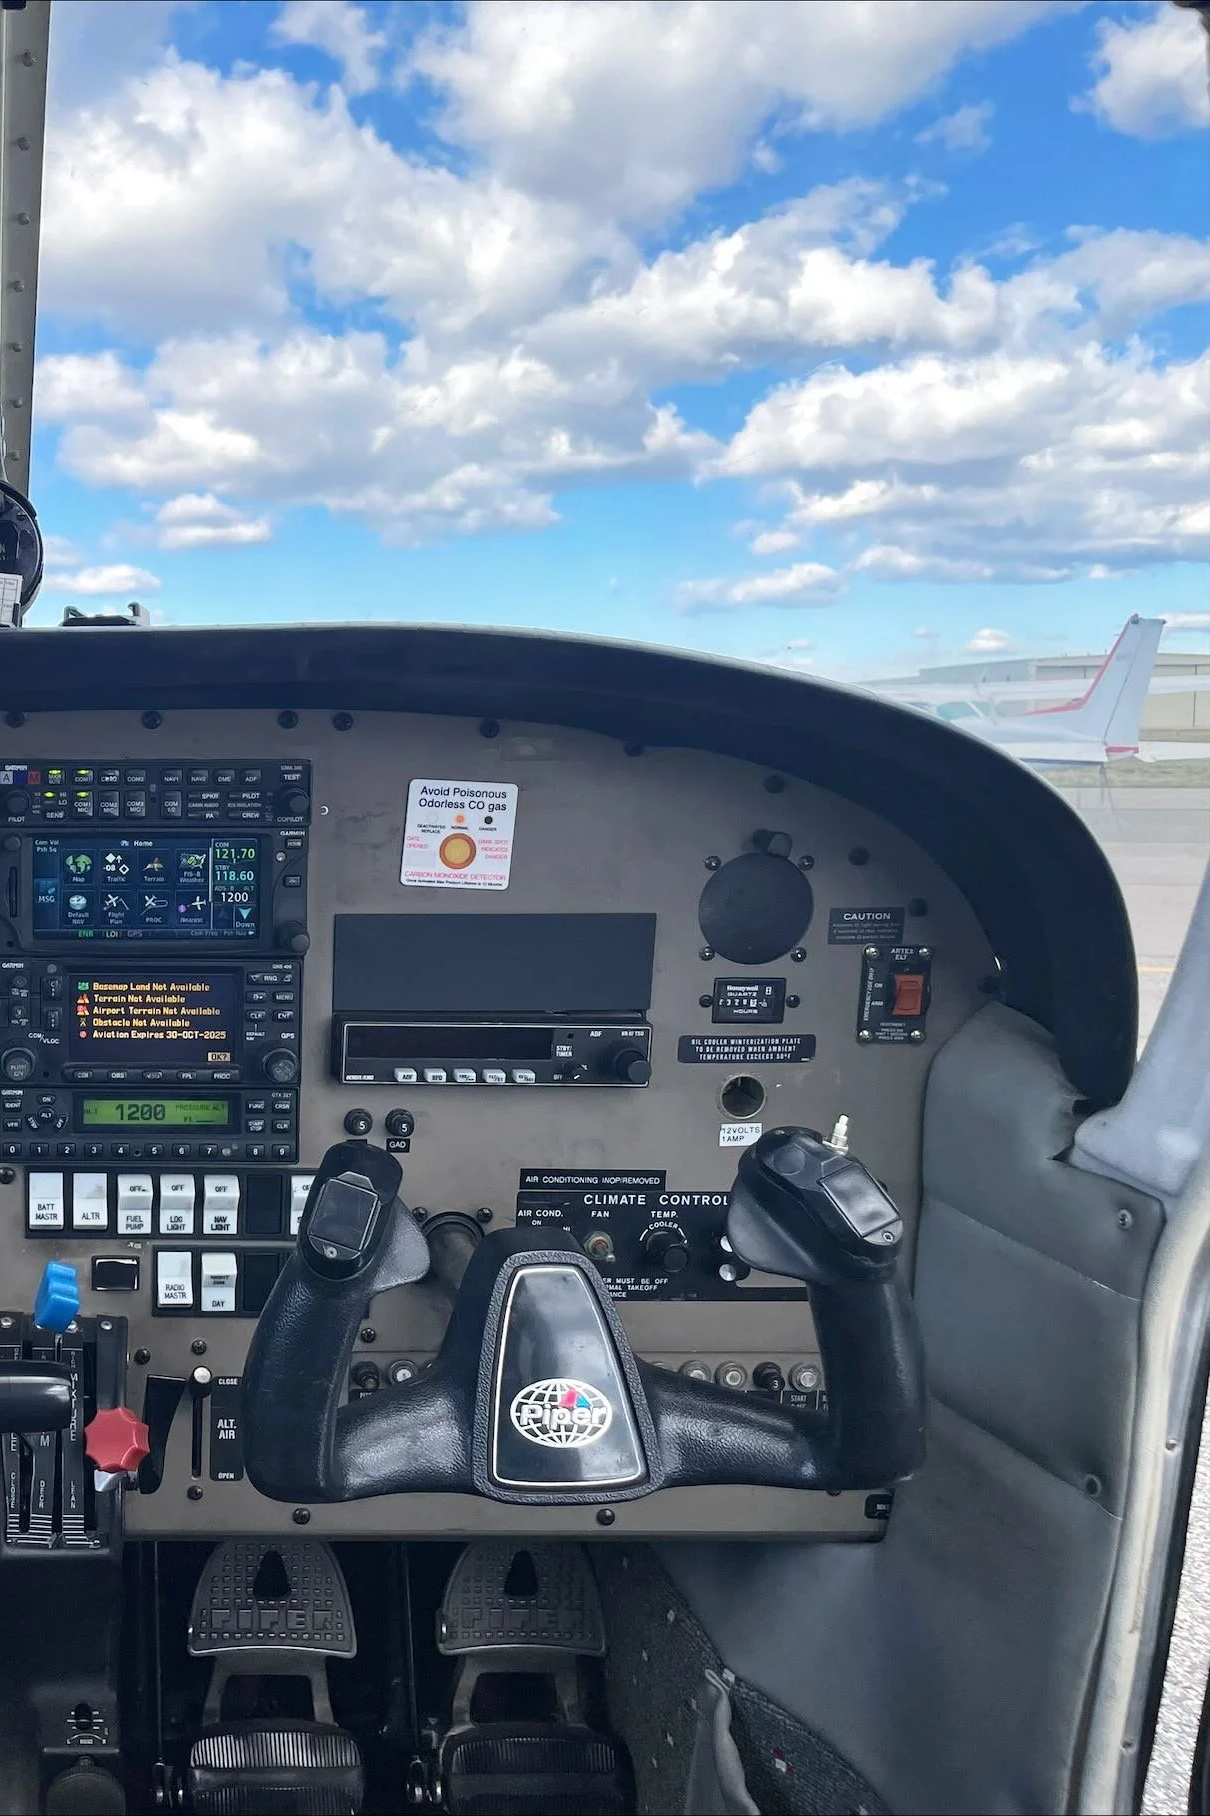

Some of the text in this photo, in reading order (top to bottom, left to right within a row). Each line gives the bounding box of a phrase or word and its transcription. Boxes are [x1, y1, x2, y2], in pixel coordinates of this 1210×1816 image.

[420, 786, 507, 798] Avoid Poisonous
[419, 798, 506, 812] Odorless CO gas
[215, 848, 255, 859] 121.70
[215, 871, 254, 881] 118.60
[220, 892, 248, 902] 1200
[93, 982, 210, 992] Basemap Land Not Available
[94, 994, 185, 1003] Terrain Not Available
[93, 1006, 220, 1016] Airport Terrain Not Available
[93, 1018, 190, 1028] Obstacle Not Available
[93, 1030, 226, 1040] Aviation Expires 30-OCT-2025
[115, 1104, 166, 1121] 1200
[543, 1176, 598, 1184] CONDITIONING
[602, 1177, 660, 1185] INOP/REMOVED
[584, 1195, 728, 1205] CLIMATE CONTROL
[36, 1213, 58, 1221] MASTR
[82, 1212, 100, 1220] ALTR
[649, 1221, 678, 1231] COOLER
[164, 1291, 187, 1299] MASTR
[520, 1401, 608, 1430] Piper
[217, 1419, 237, 1429] ALT.
[218, 1429, 235, 1440] AIR
